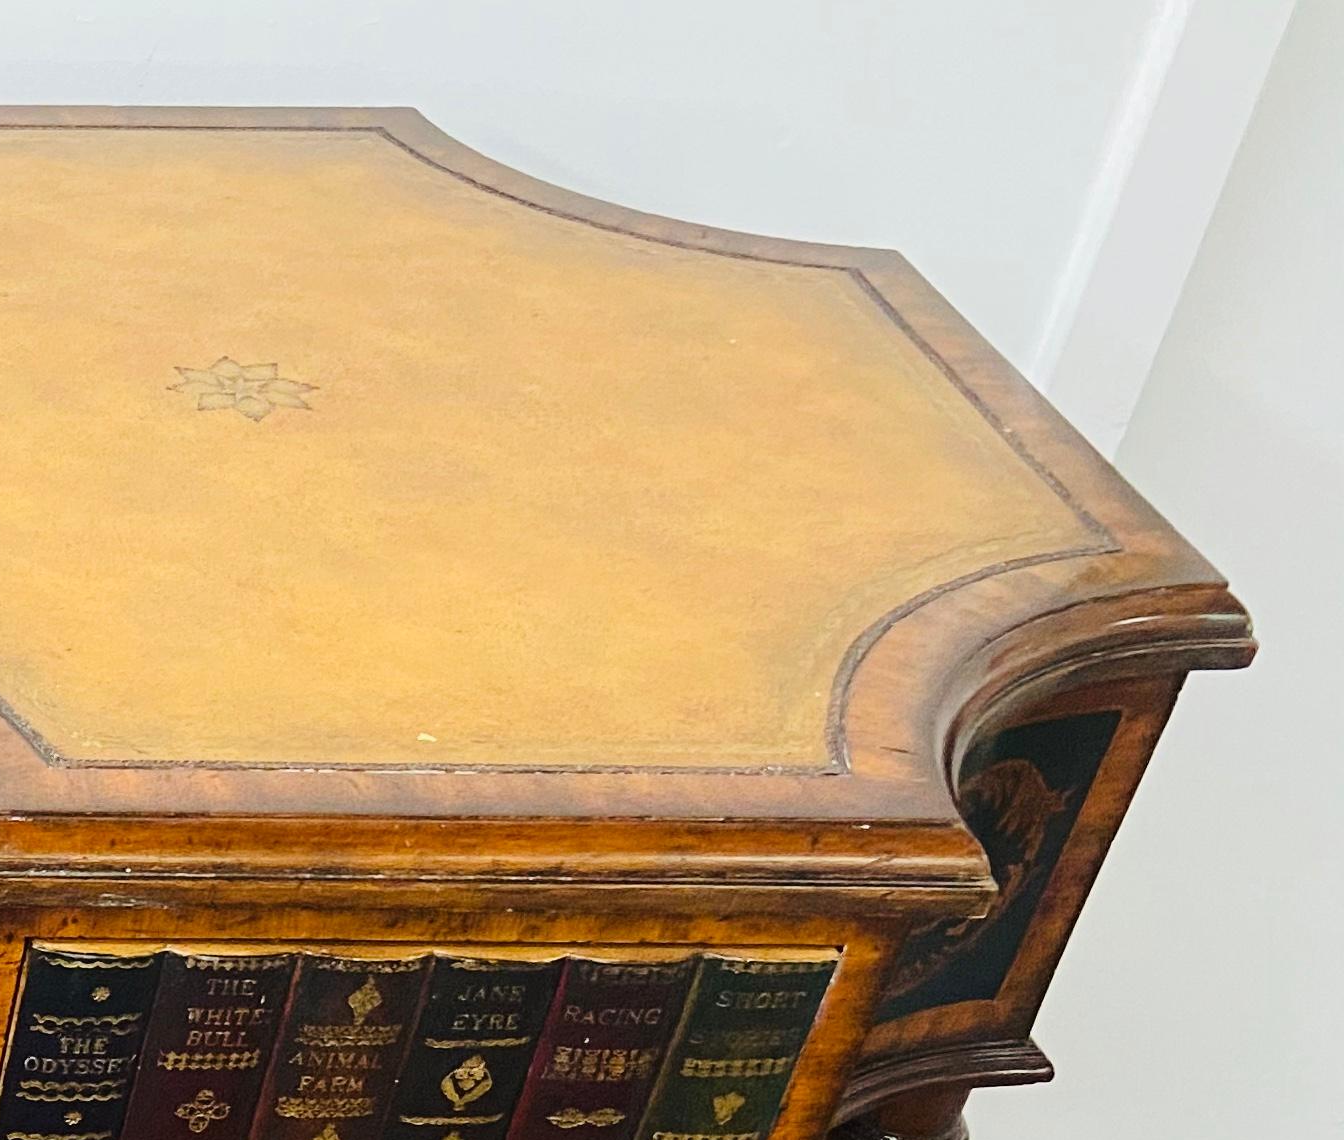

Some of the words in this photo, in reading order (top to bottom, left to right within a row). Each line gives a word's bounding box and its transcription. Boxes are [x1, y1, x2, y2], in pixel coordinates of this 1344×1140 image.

[206, 978, 258, 997] THE
[456, 984, 527, 1002] JANE
[714, 990, 809, 1009] SHORT
[186, 1007, 269, 1026] WHITE
[450, 1013, 522, 1031] EYRE
[563, 1005, 662, 1026] RACING
[59, 1034, 111, 1055] THE
[185, 1030, 250, 1048] BULL
[288, 1051, 383, 1069] ANIMAL
[296, 1075, 363, 1093] FARM
